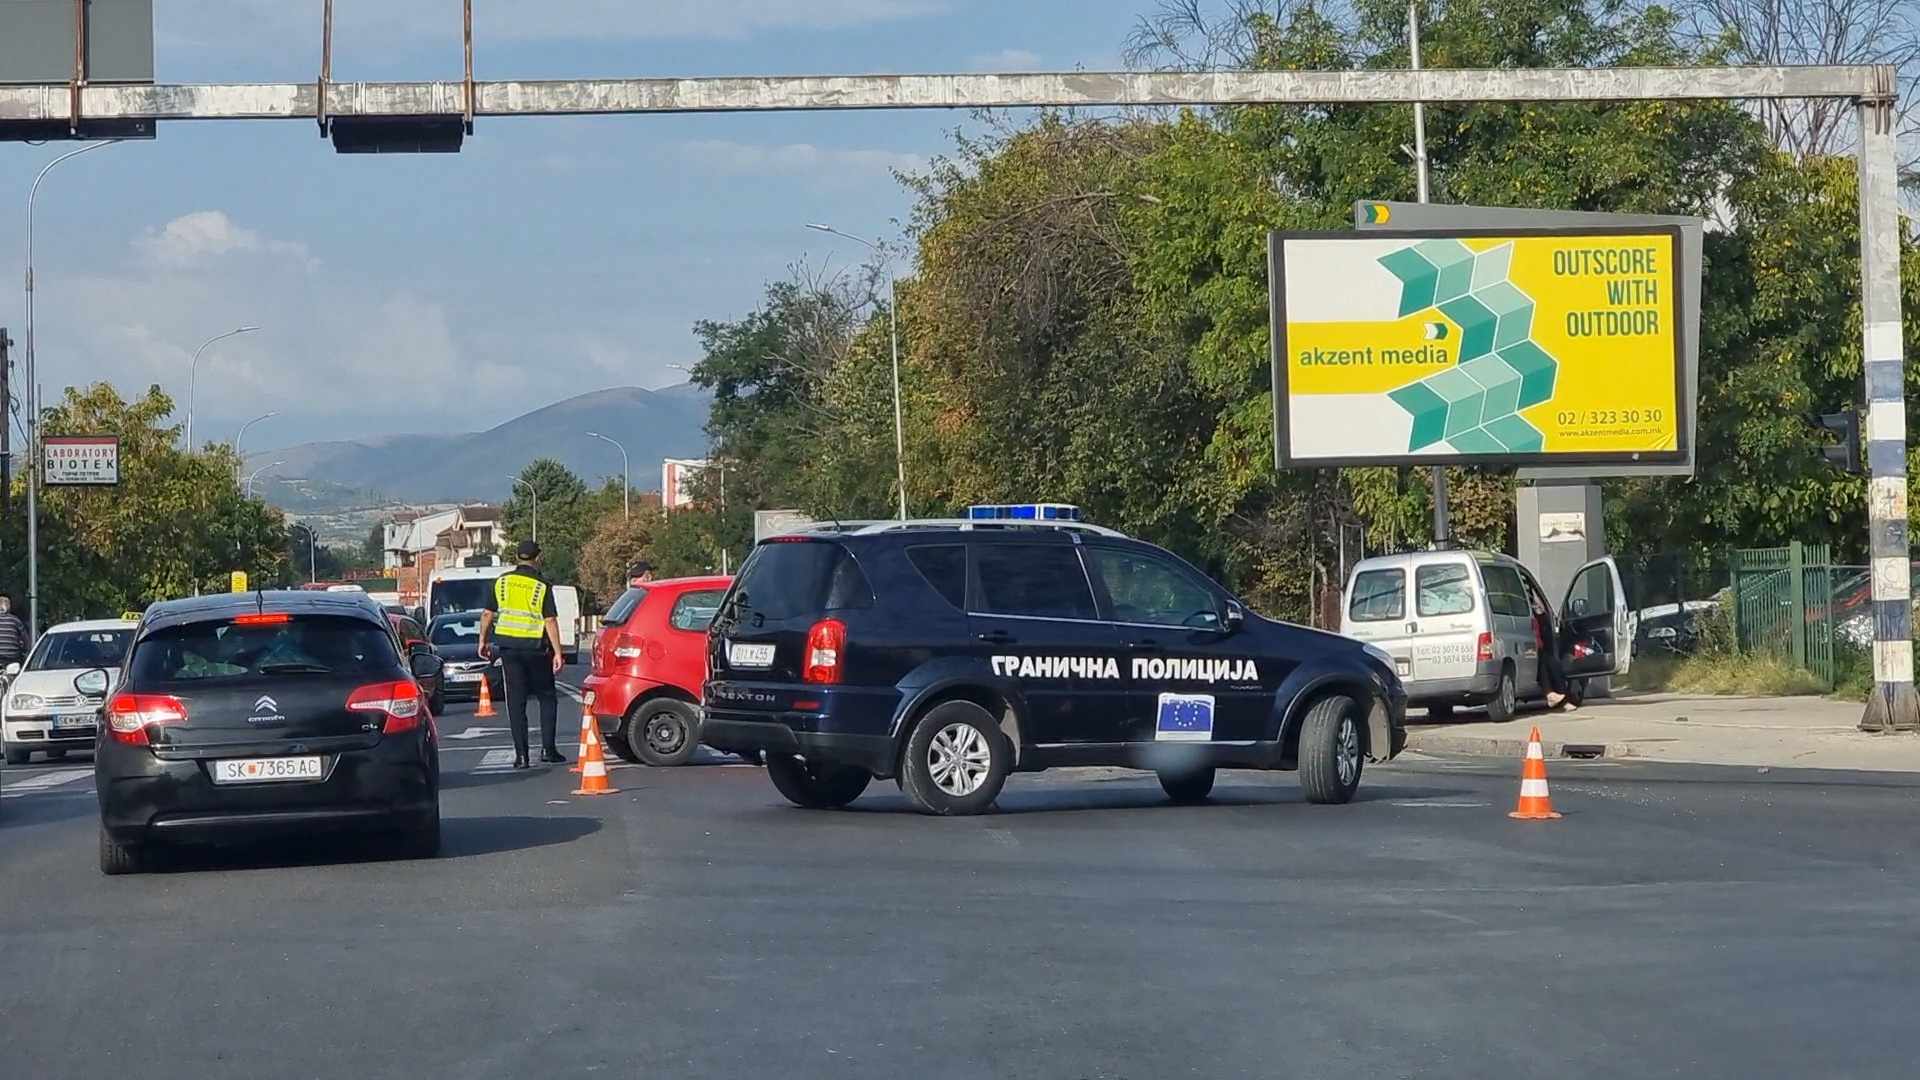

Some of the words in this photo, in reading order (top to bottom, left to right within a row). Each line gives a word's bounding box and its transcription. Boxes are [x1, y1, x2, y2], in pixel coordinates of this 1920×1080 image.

[1553, 248, 1657, 276] OUTSCORE
[1606, 279, 1658, 305] WITH
[1566, 310, 1659, 337] OUTDOOR
[1299, 347, 1373, 366] akzent
[1381, 344, 1449, 364] media
[1557, 411, 1576, 425] 02
[1590, 410, 1617, 424] 323
[1621, 409, 1640, 423] 30
[1643, 408, 1662, 422] 30
[47, 448, 115, 458] LABORATORY
[47, 459, 114, 470] BIOTEK
[990, 655, 1120, 680] ГРАНИЧНА
[1131, 657, 1259, 684] ПОЛИЦИЈА
[227, 762, 246, 778] SK
[256, 759, 296, 777] 7365
[299, 759, 318, 775] AC
